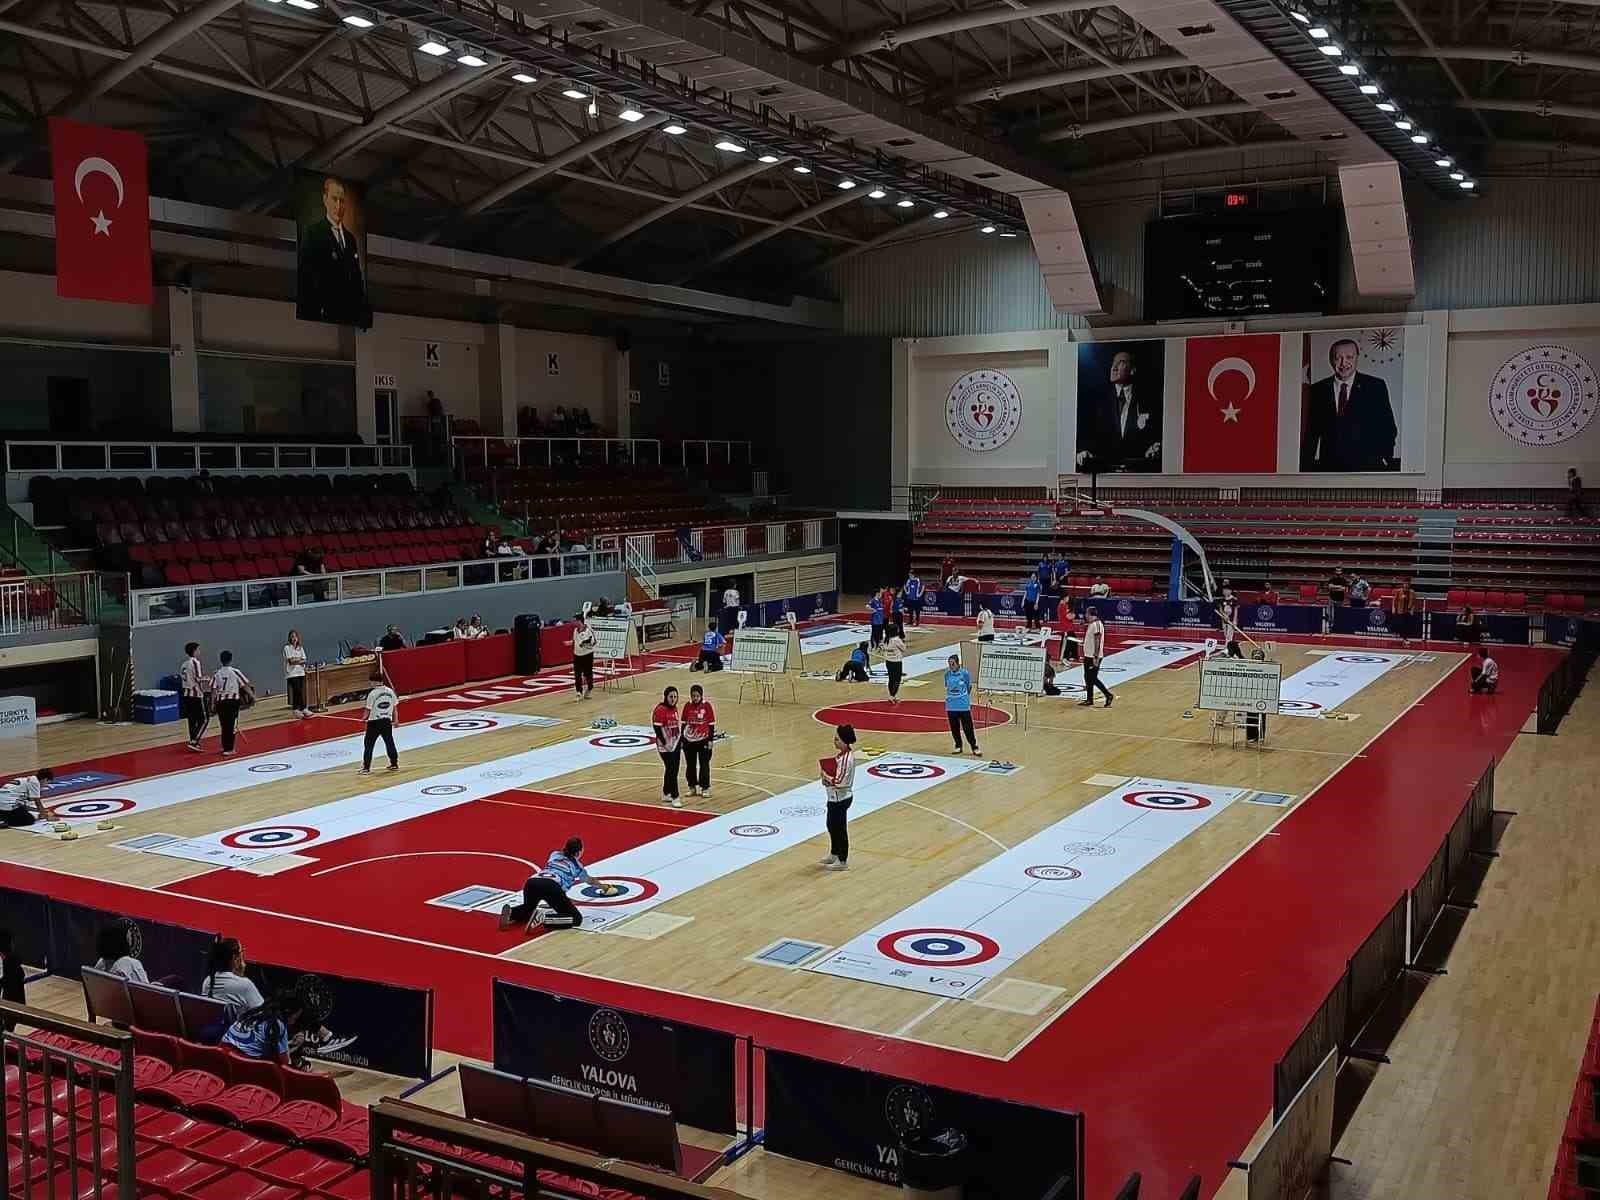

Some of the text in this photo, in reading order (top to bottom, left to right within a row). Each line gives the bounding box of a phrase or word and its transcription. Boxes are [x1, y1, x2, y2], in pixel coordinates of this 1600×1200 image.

[426, 343, 438, 361] K
[549, 354, 558, 369] K
[222, 677, 228, 691] 7
[580, 1063, 638, 1093] YALOVA
